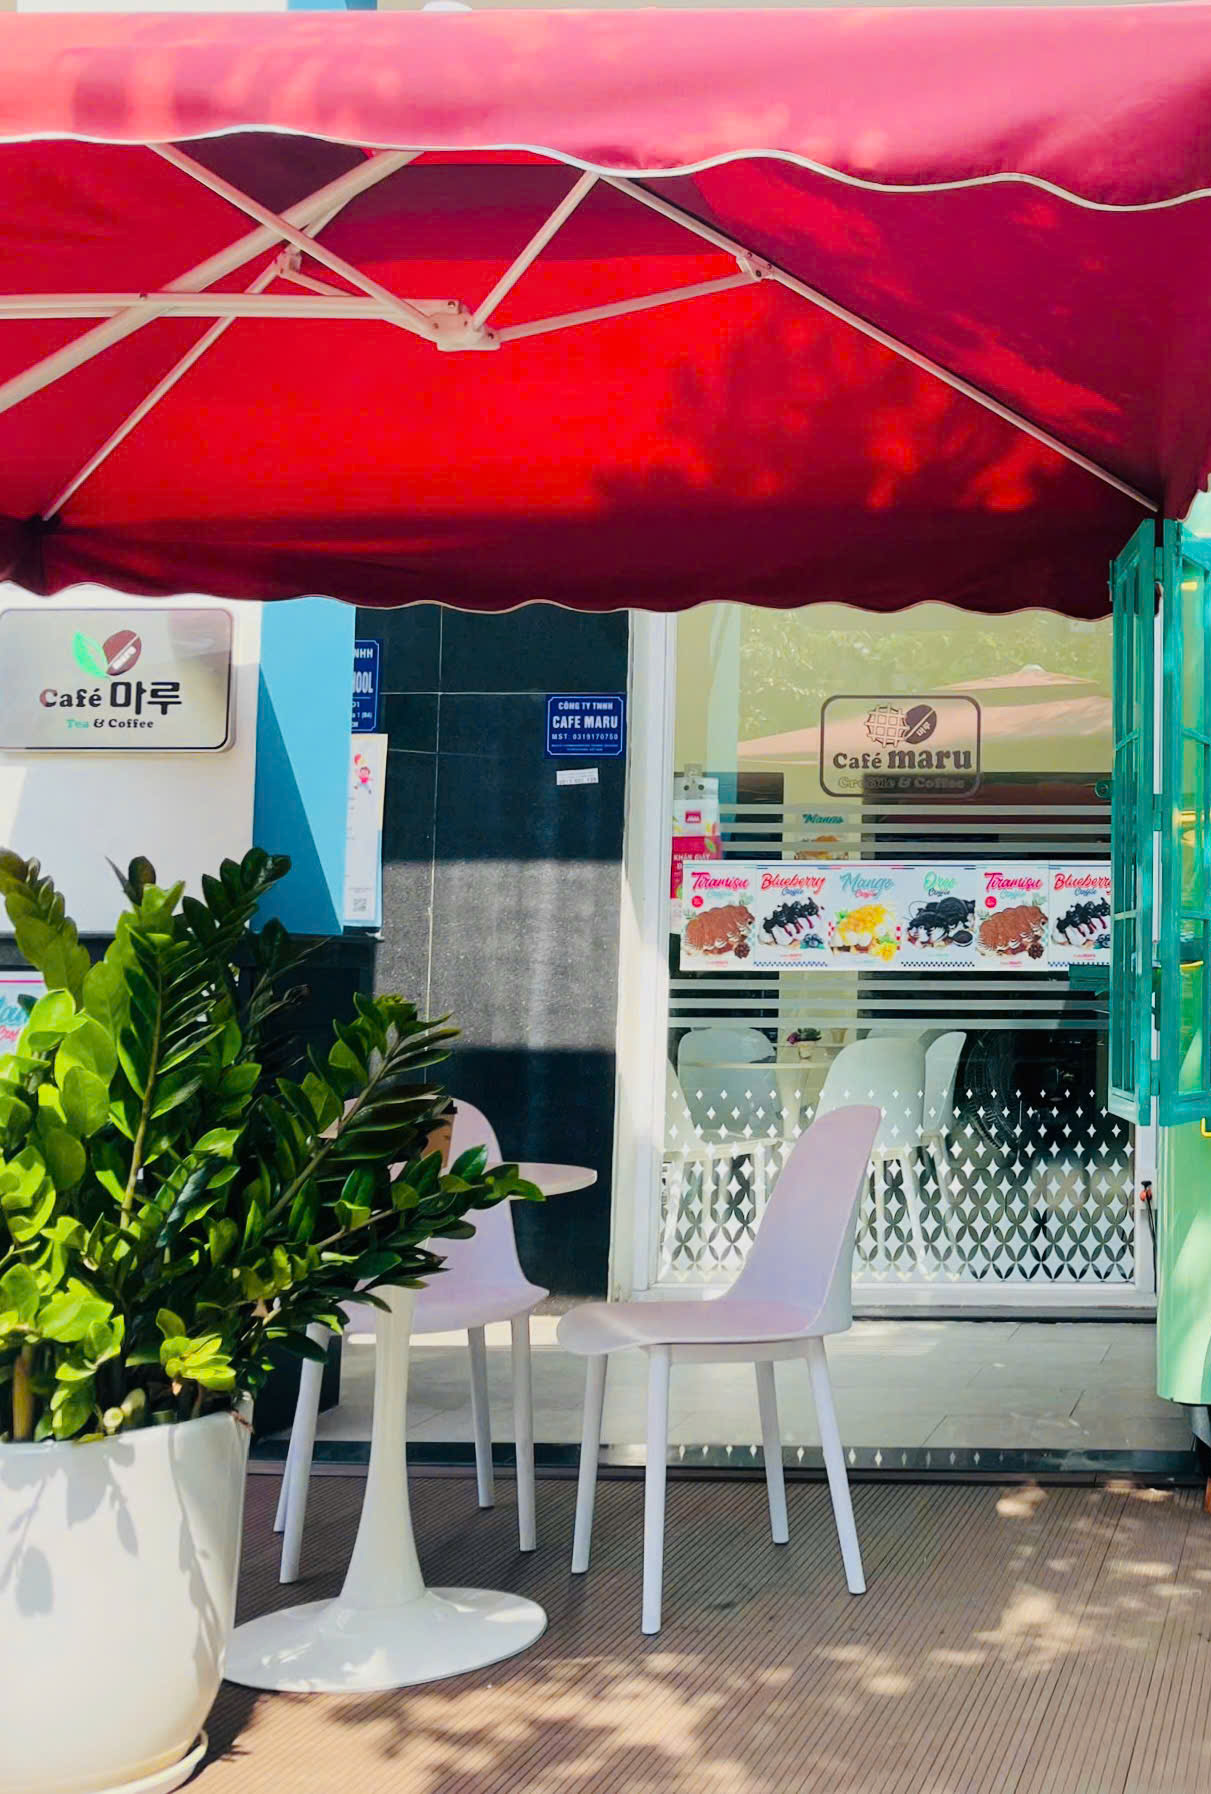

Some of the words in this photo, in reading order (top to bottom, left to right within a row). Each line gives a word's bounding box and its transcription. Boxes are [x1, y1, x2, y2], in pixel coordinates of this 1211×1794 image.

[39, 688, 102, 708] Café
[110, 681, 182, 715] 마루
[66, 719, 89, 729] Tea
[108, 718, 154, 728] Coffee
[552, 715, 581, 729] CAFE
[583, 715, 618, 729] MARU
[833, 752, 882, 769] Café
[887, 749, 972, 769] maru
[691, 872, 749, 891] Tiramisu
[761, 873, 826, 895] Blueberry
[840, 873, 894, 895] Mango
[984, 872, 1042, 892] Tiramisu
